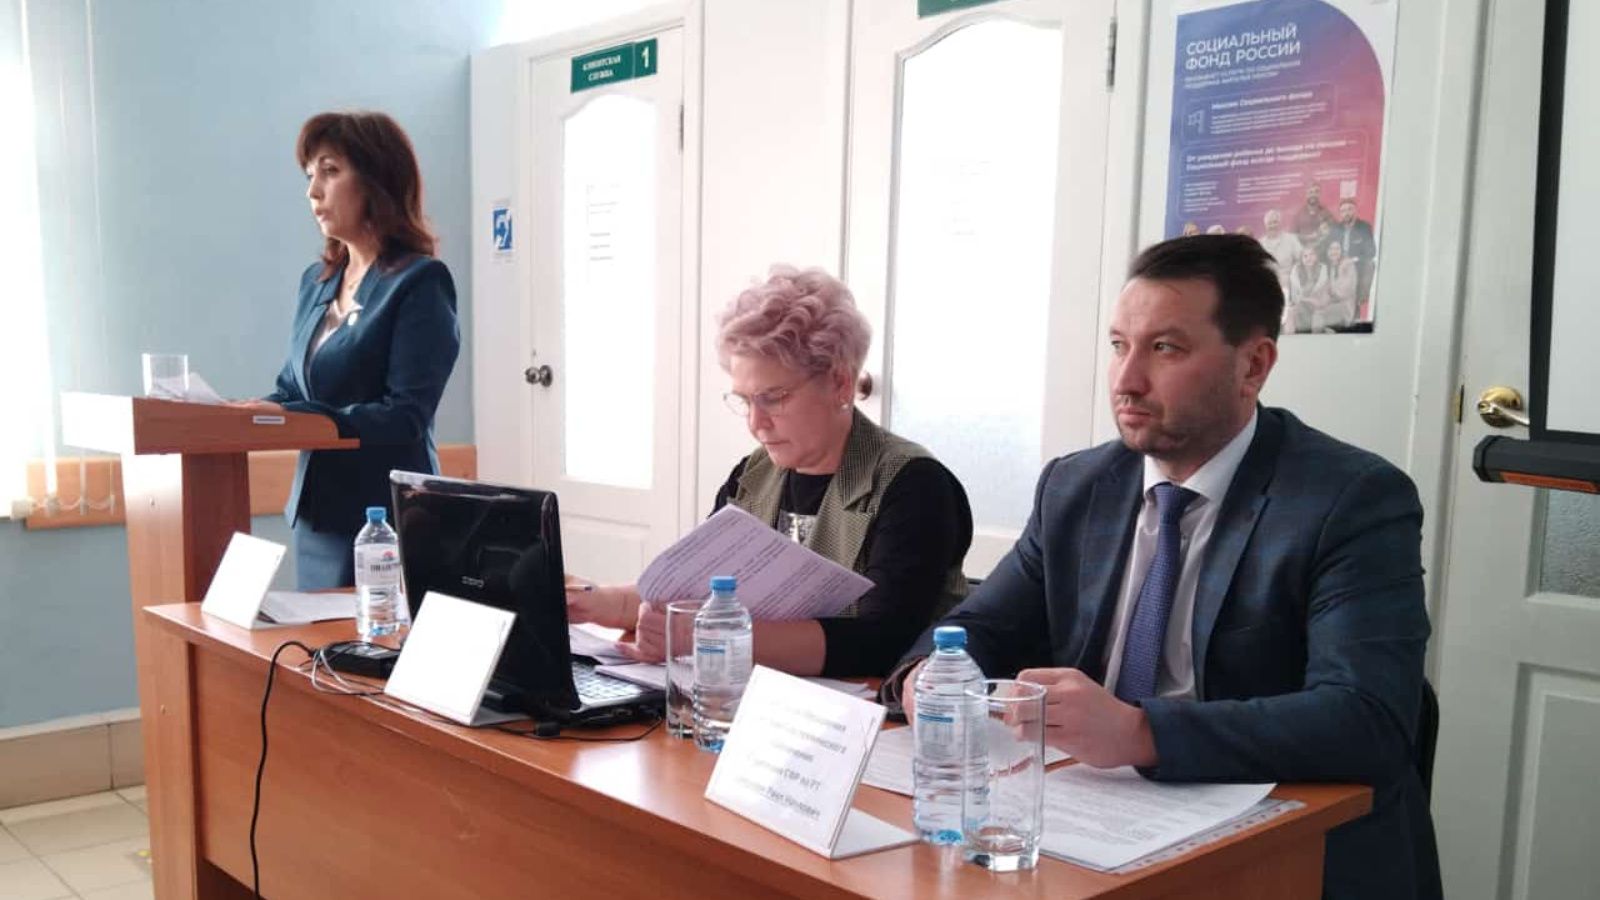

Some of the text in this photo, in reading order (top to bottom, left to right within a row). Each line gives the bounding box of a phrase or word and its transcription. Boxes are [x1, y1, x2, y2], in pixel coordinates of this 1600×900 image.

[1185, 22, 1298, 55] СОЦИАЛЬНЫЙ
[641, 46, 650, 68] 1
[1185, 41, 1300, 70] ФОНД РОССИИ
